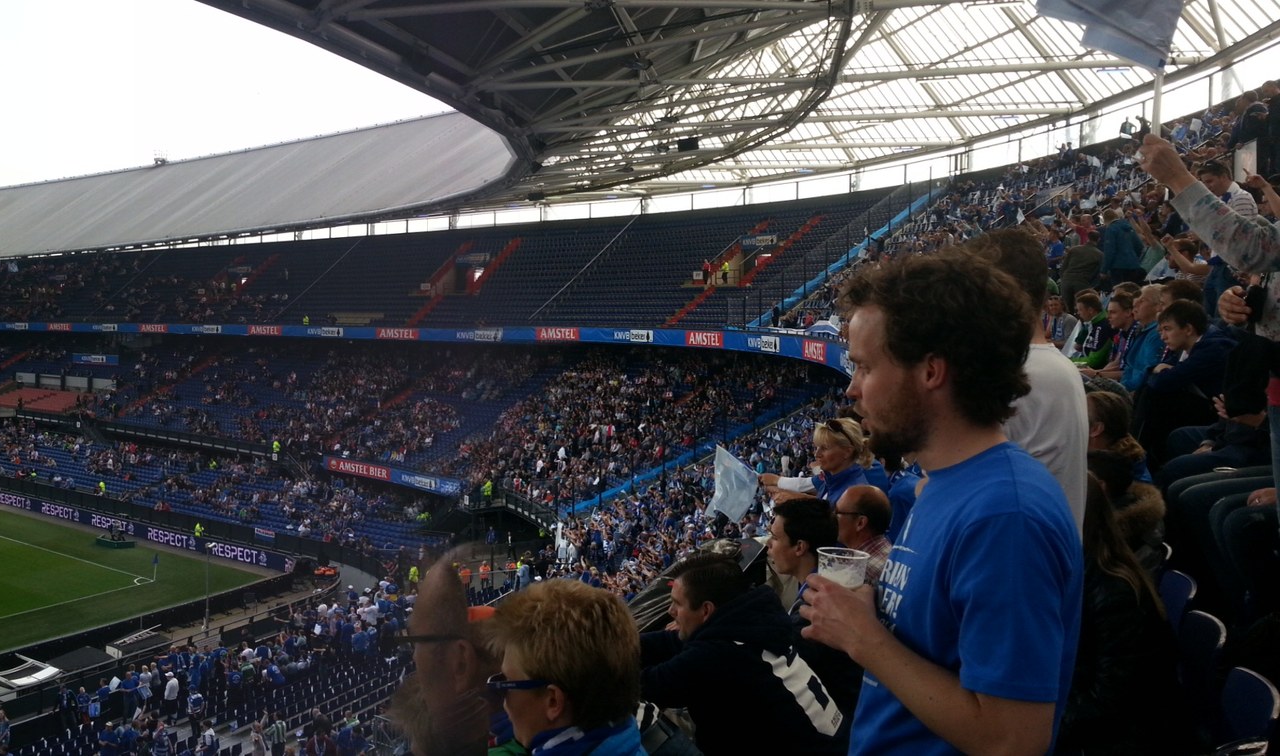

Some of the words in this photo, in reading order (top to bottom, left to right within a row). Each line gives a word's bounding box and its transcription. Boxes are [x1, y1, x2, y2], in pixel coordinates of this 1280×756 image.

[251, 327, 279, 335] AMSTEL
[380, 329, 414, 338] AMSTEL
[540, 328, 576, 339] AMSTEL
[614, 332, 630, 341] KNVB
[631, 332, 646, 341] beker
[689, 331, 721, 346] AMSTEL
[748, 338, 761, 350] KNVB
[805, 341, 825, 361] AMSTEL
[338, 462, 368, 475] AMSTEL
[369, 467, 388, 479] BIER
[41, 502, 73, 519] RESPECT
[148, 528, 188, 548] RESPECT
[212, 541, 257, 564] RESPECT
